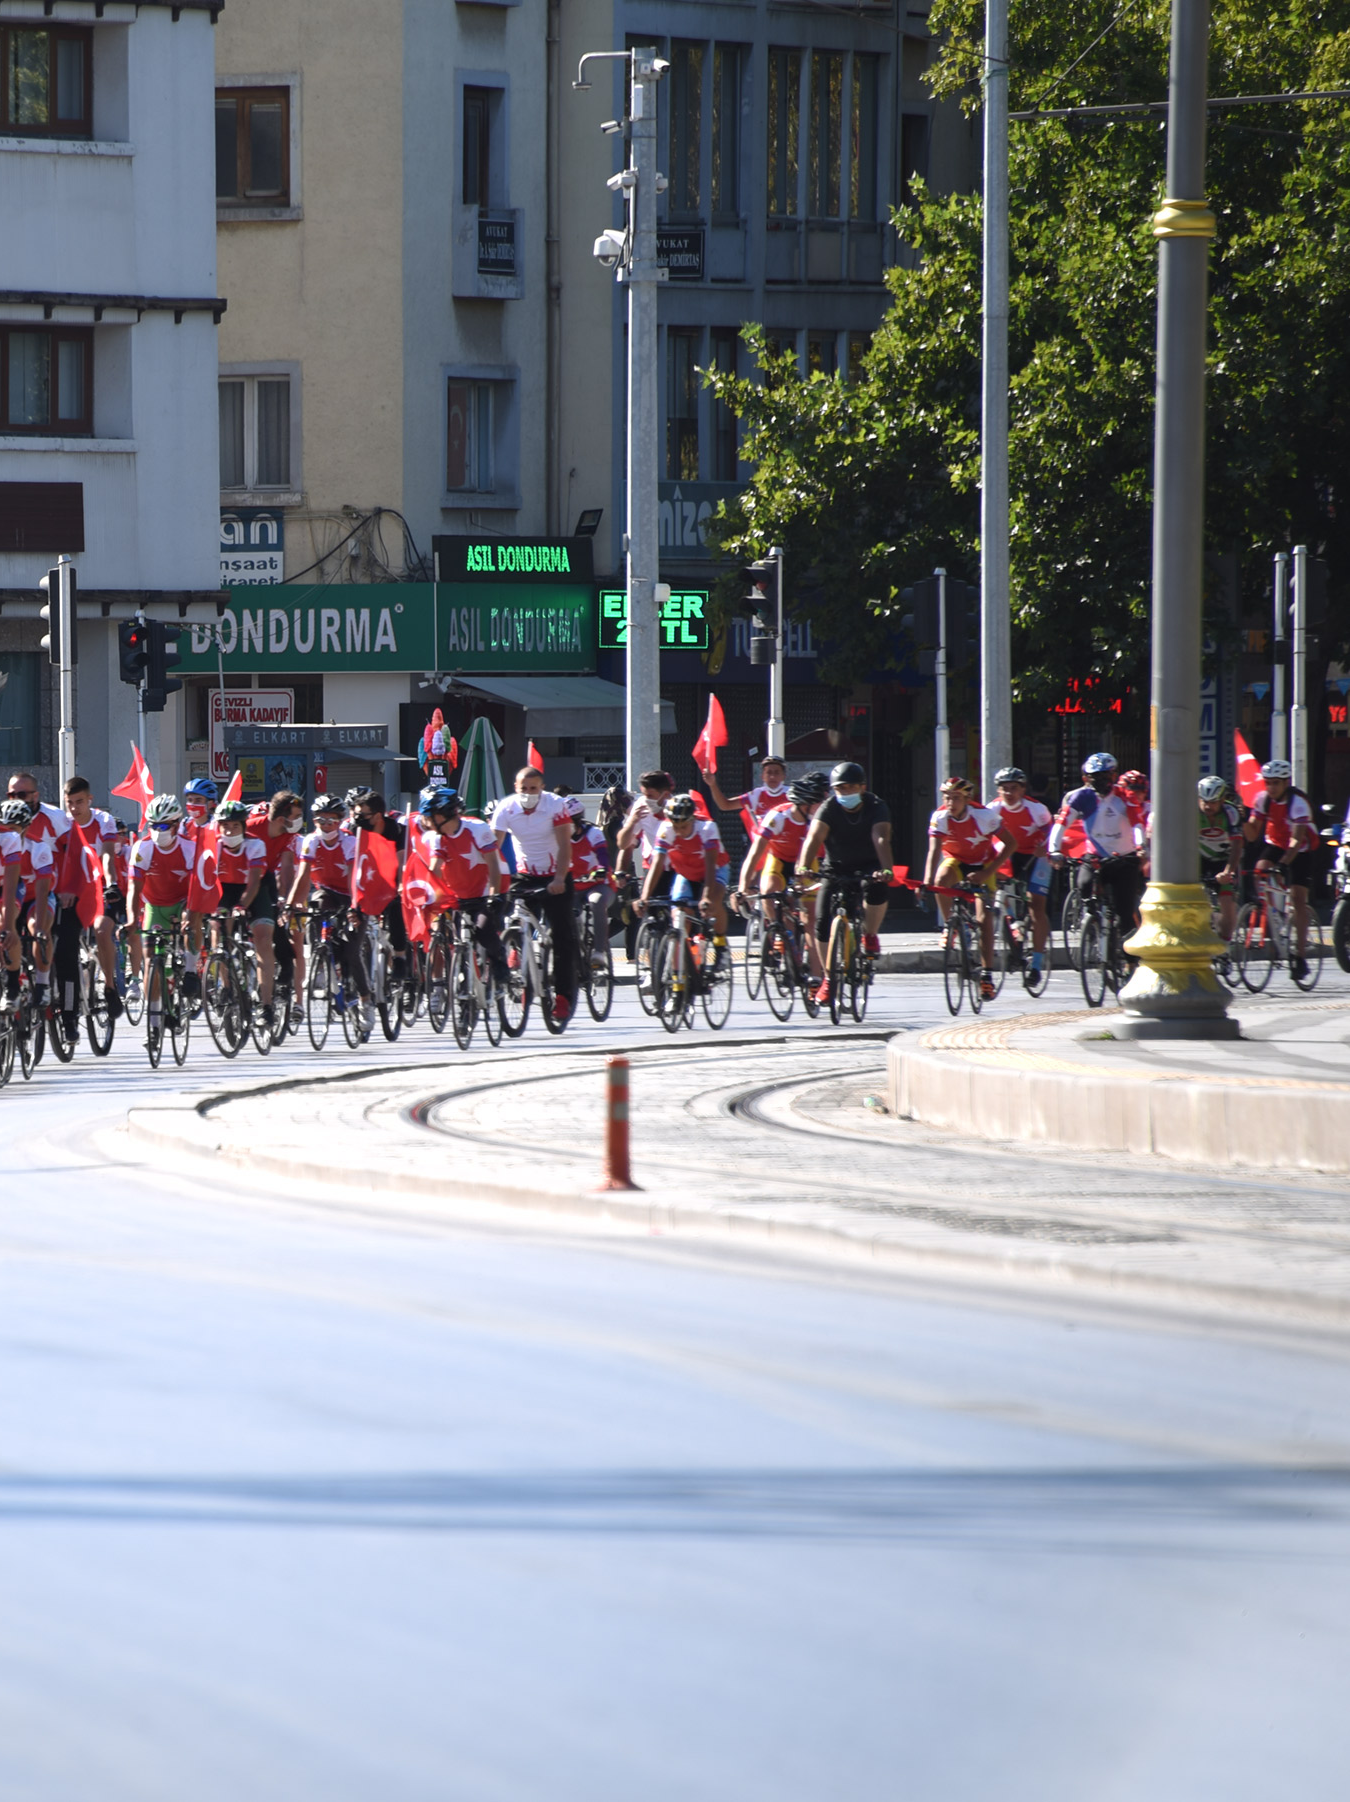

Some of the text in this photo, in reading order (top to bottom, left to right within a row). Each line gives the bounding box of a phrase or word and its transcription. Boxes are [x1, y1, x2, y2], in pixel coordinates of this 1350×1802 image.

[656, 239, 689, 248] VUKAT
[220, 557, 278, 572] nşaat
[466, 545, 571, 573] ASIL DONDURMA
[220, 575, 278, 586] icaret
[603, 594, 705, 619] EER
[191, 607, 398, 654] DONDURMA
[449, 607, 583, 653] ASIL DONDURMA
[661, 620, 698, 643] TL
[731, 617, 818, 658] TUELL
[250, 708, 289, 722] KADAYIF
[253, 732, 307, 744] ELKART
[339, 729, 384, 743] ELKART
